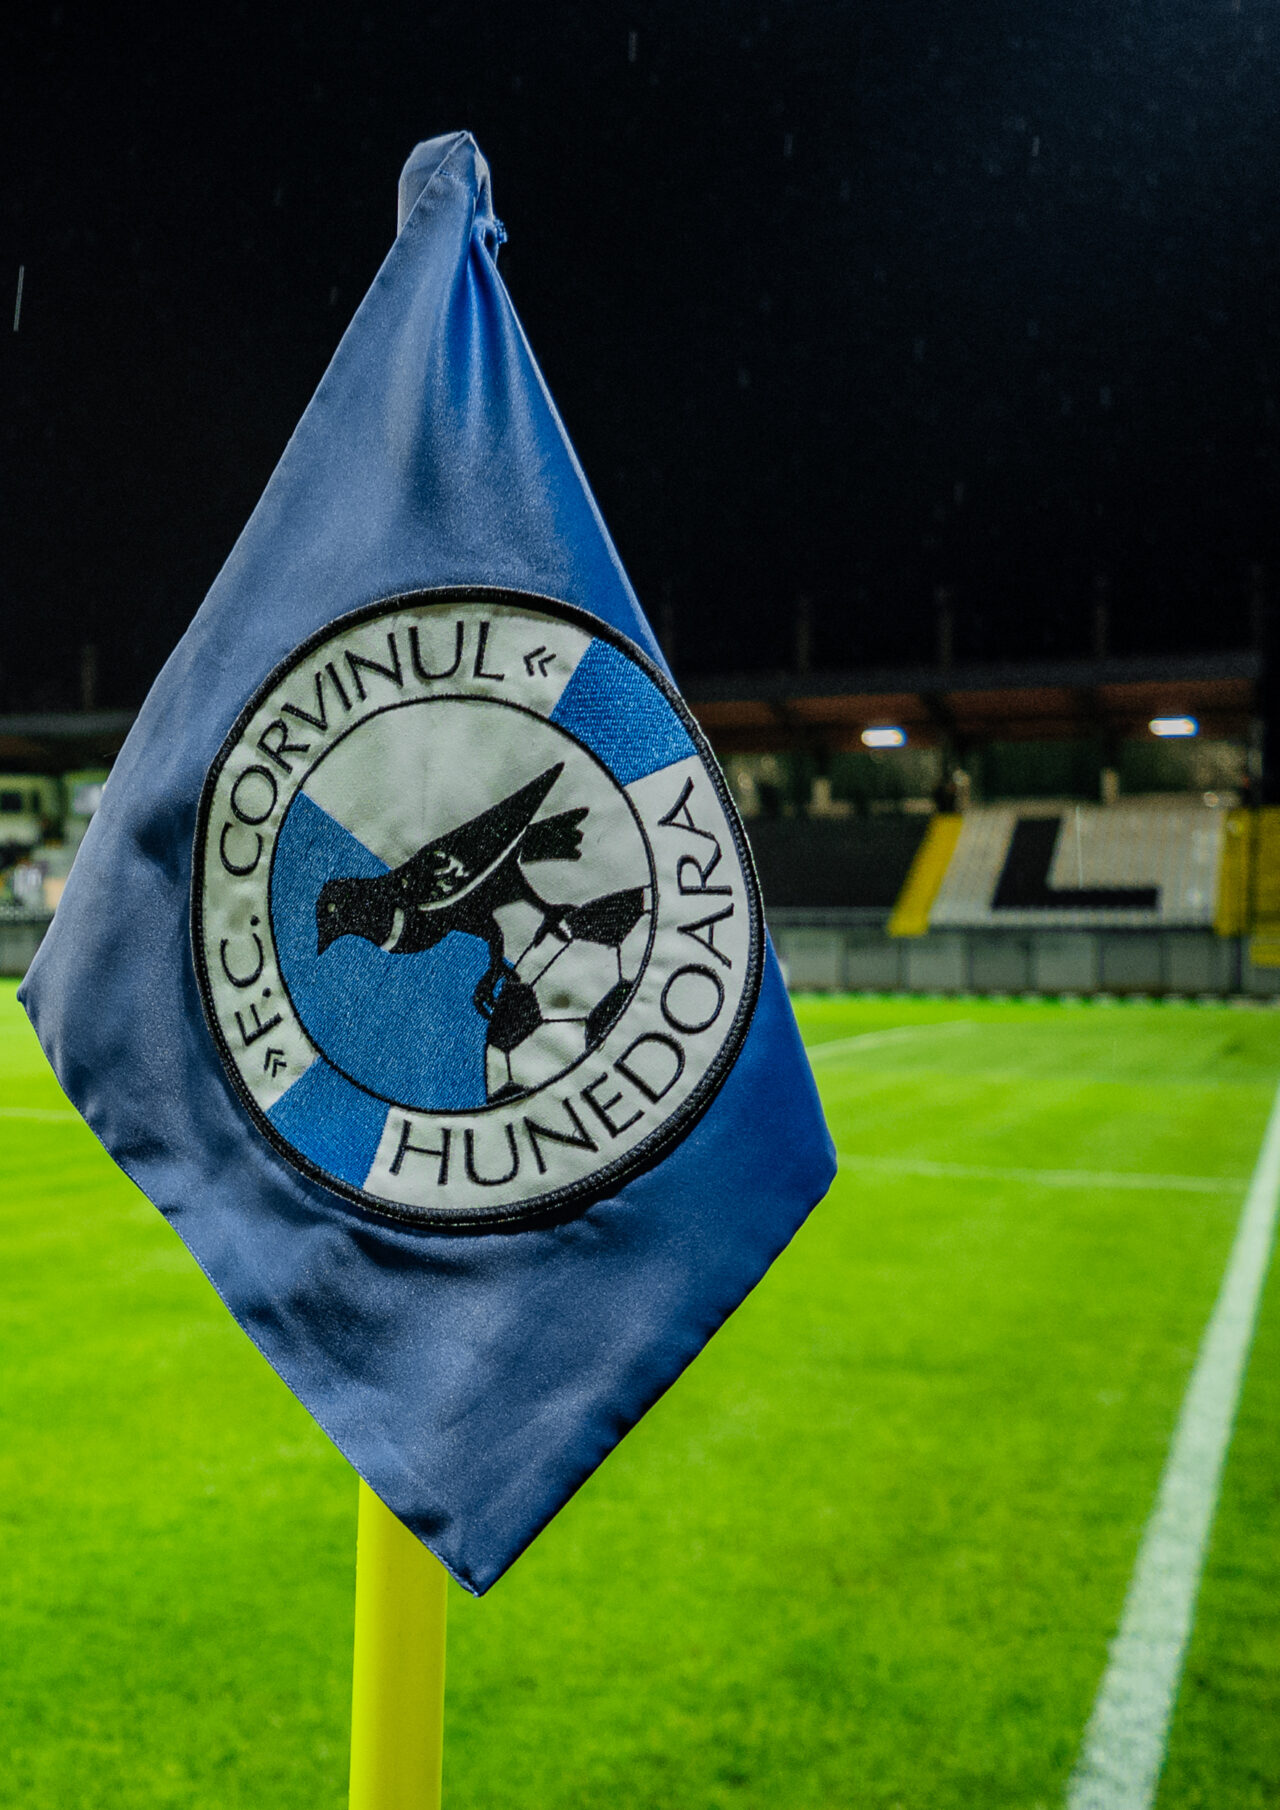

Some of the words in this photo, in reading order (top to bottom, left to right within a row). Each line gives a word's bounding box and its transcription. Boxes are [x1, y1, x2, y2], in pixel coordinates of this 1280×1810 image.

[219, 620, 506, 877] CORVINUL
[220, 915, 284, 1047] F.C.
[388, 776, 735, 1186] HUNEDOARA
